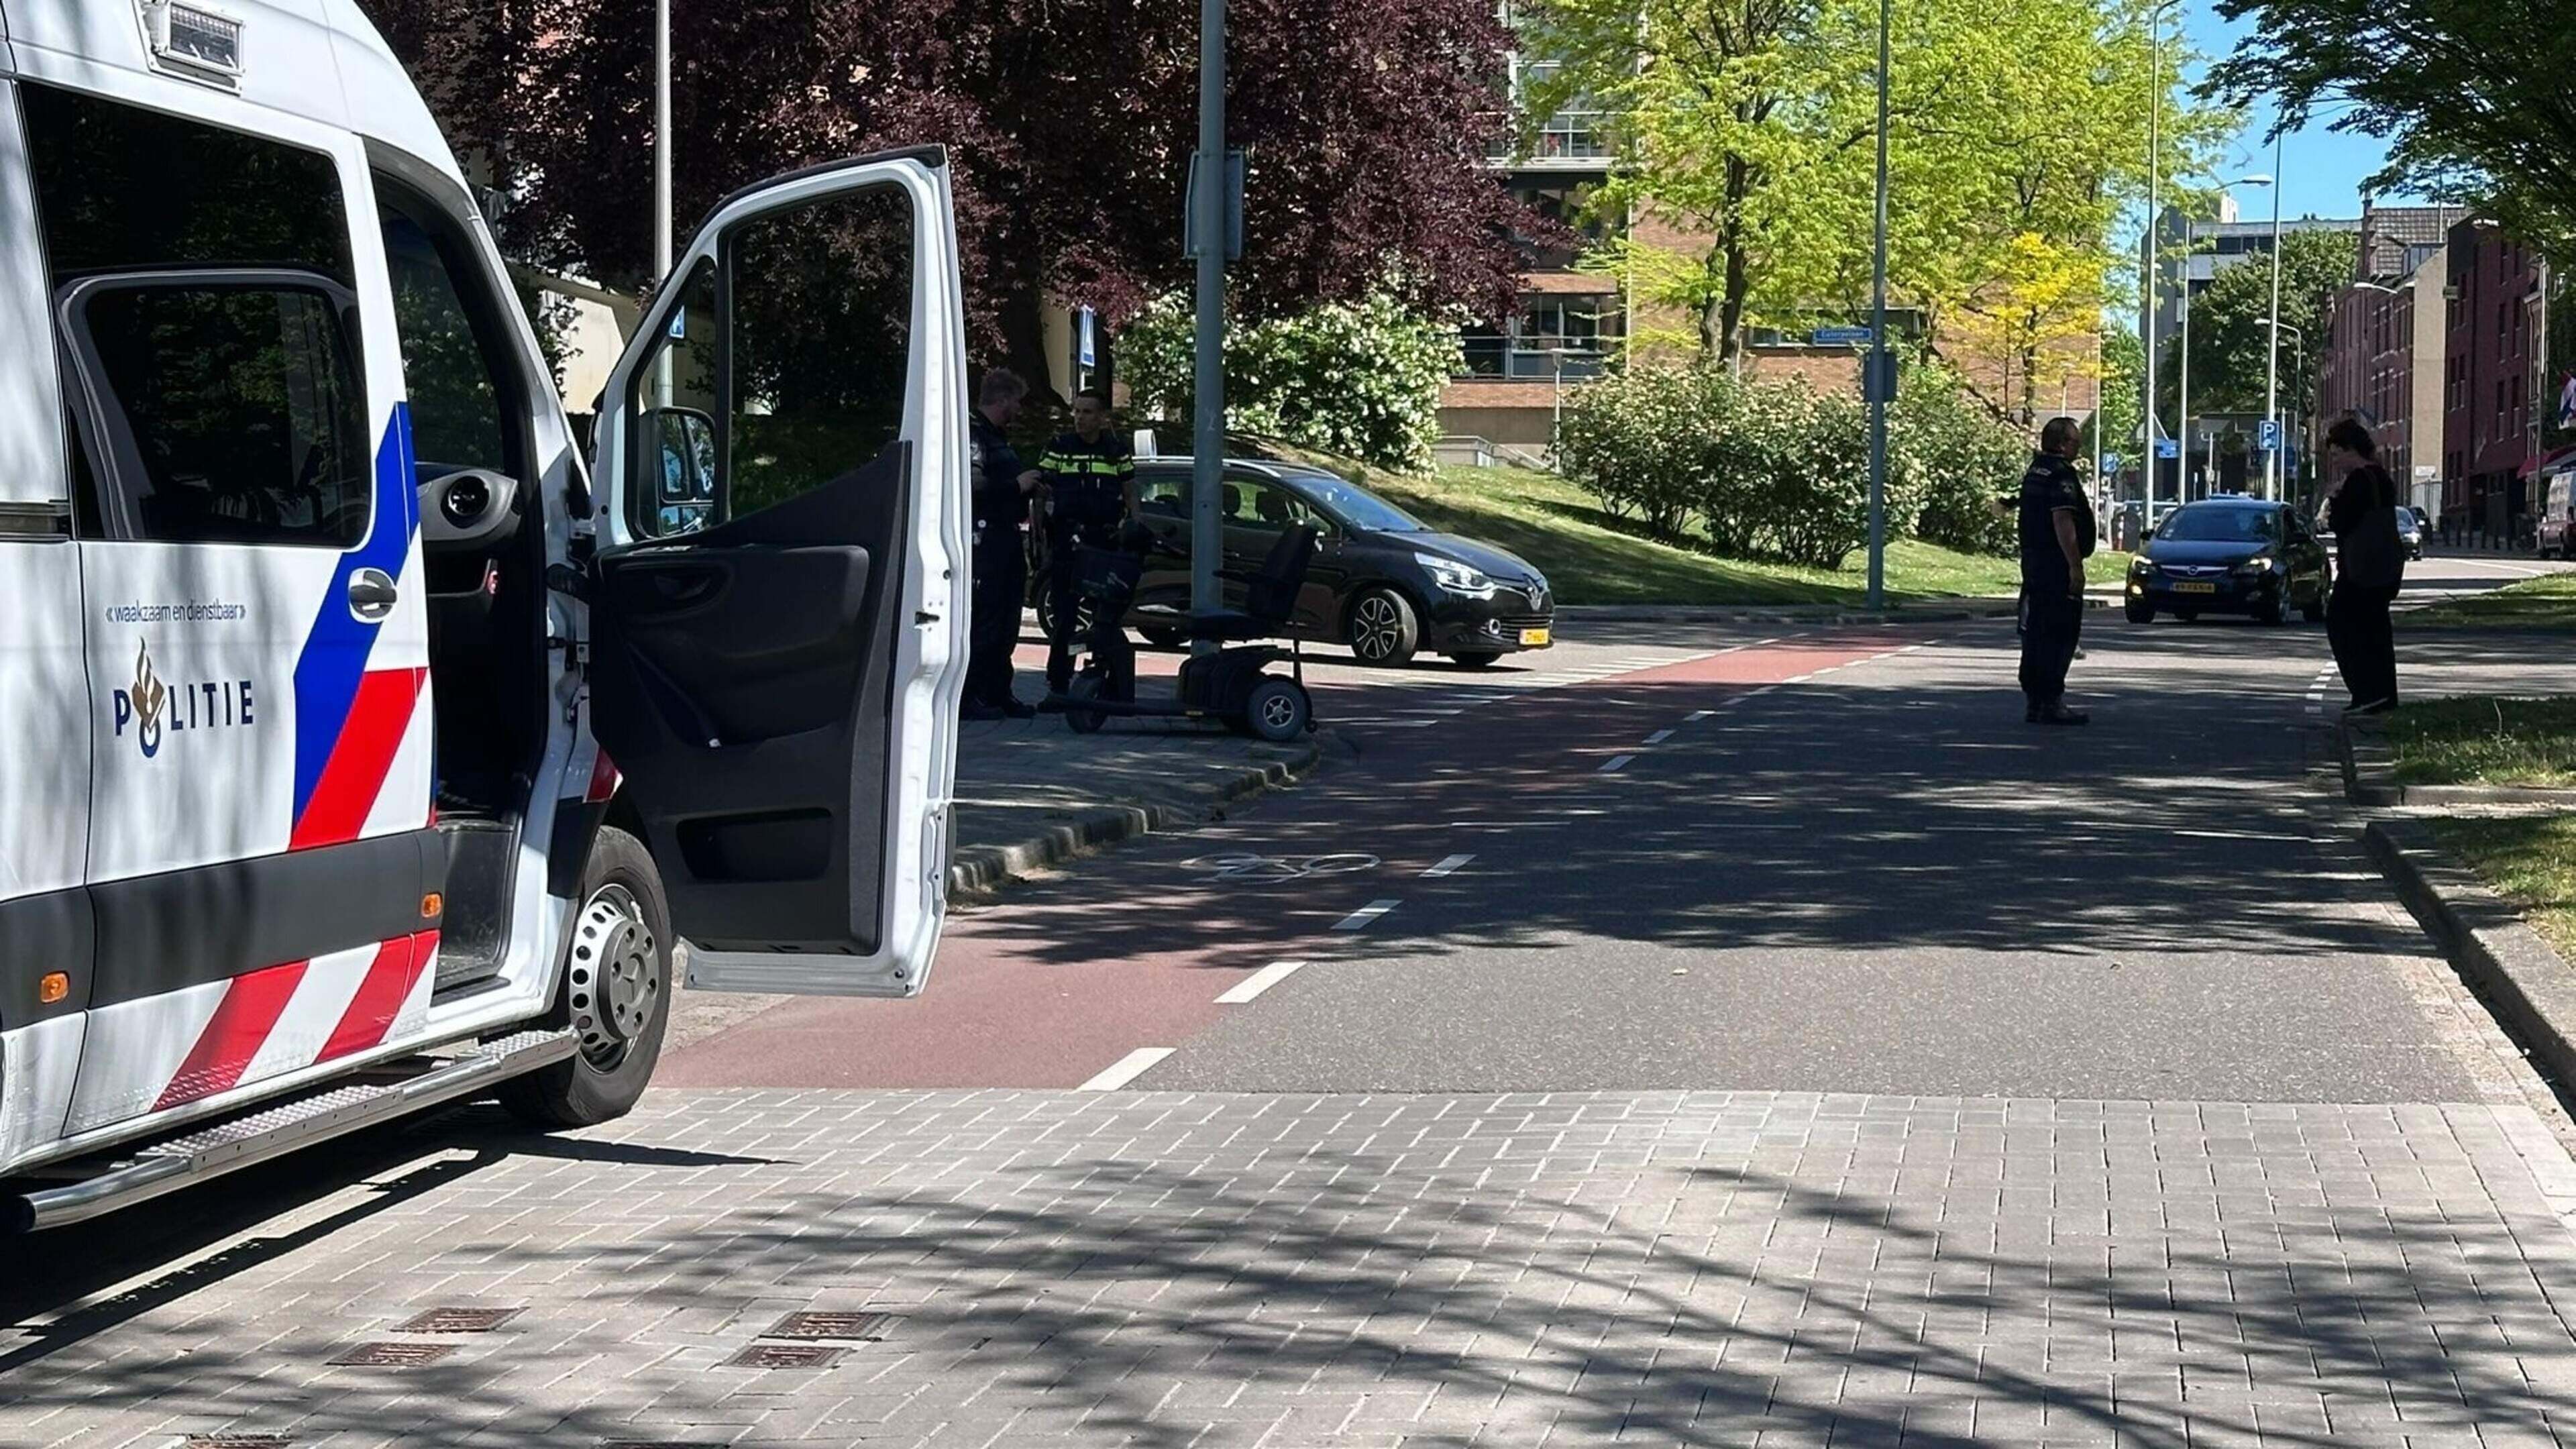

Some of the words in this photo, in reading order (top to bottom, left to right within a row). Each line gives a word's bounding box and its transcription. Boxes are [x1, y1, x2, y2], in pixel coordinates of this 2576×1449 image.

[2263, 423, 2275, 437] P
[2106, 455, 2114, 464] P
[173, 605, 185, 621] en
[113, 680, 254, 758] POLITIE
